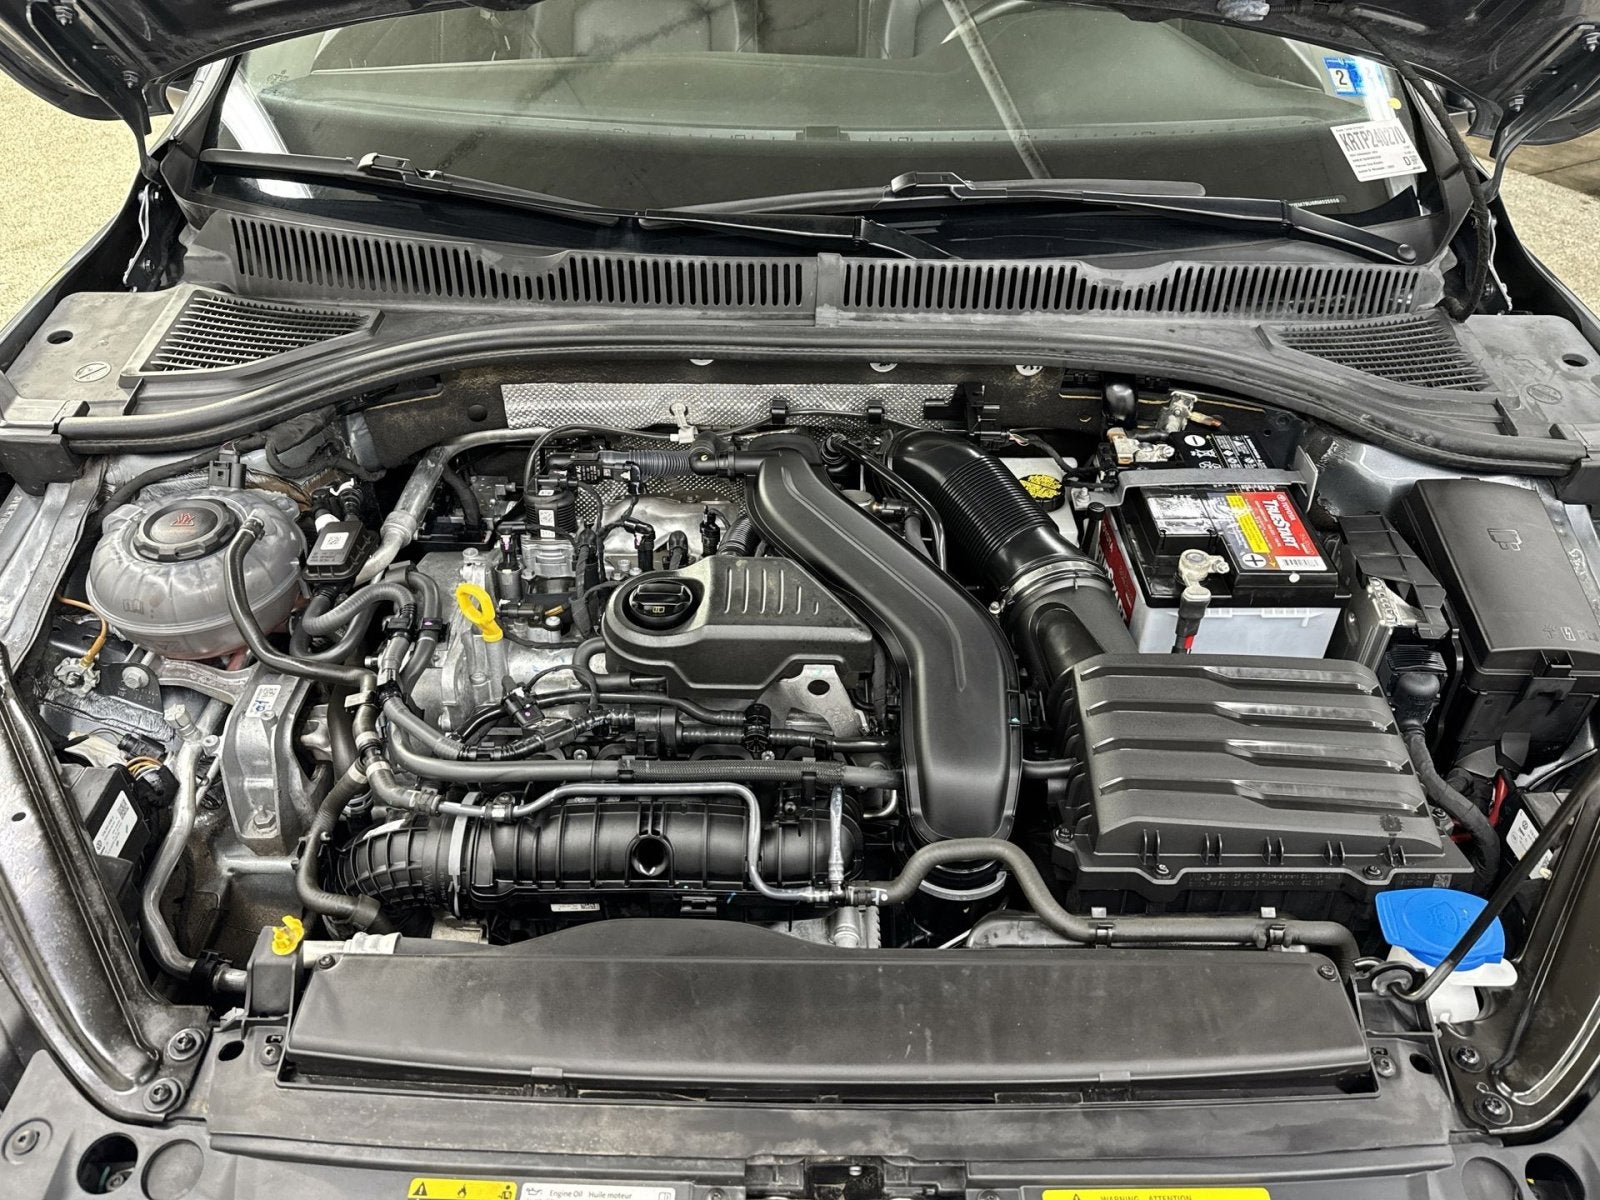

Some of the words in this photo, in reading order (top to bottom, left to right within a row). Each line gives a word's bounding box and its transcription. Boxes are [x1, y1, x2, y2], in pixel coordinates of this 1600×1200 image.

[1335, 69, 1348, 86] 2
[1339, 126, 1406, 152] KRTP240270
[1281, 501, 1299, 521] TOYOTA
[549, 1189, 571, 1199] Engine
[572, 1190, 583, 1198] Oil
[588, 1191, 604, 1199] Huile
